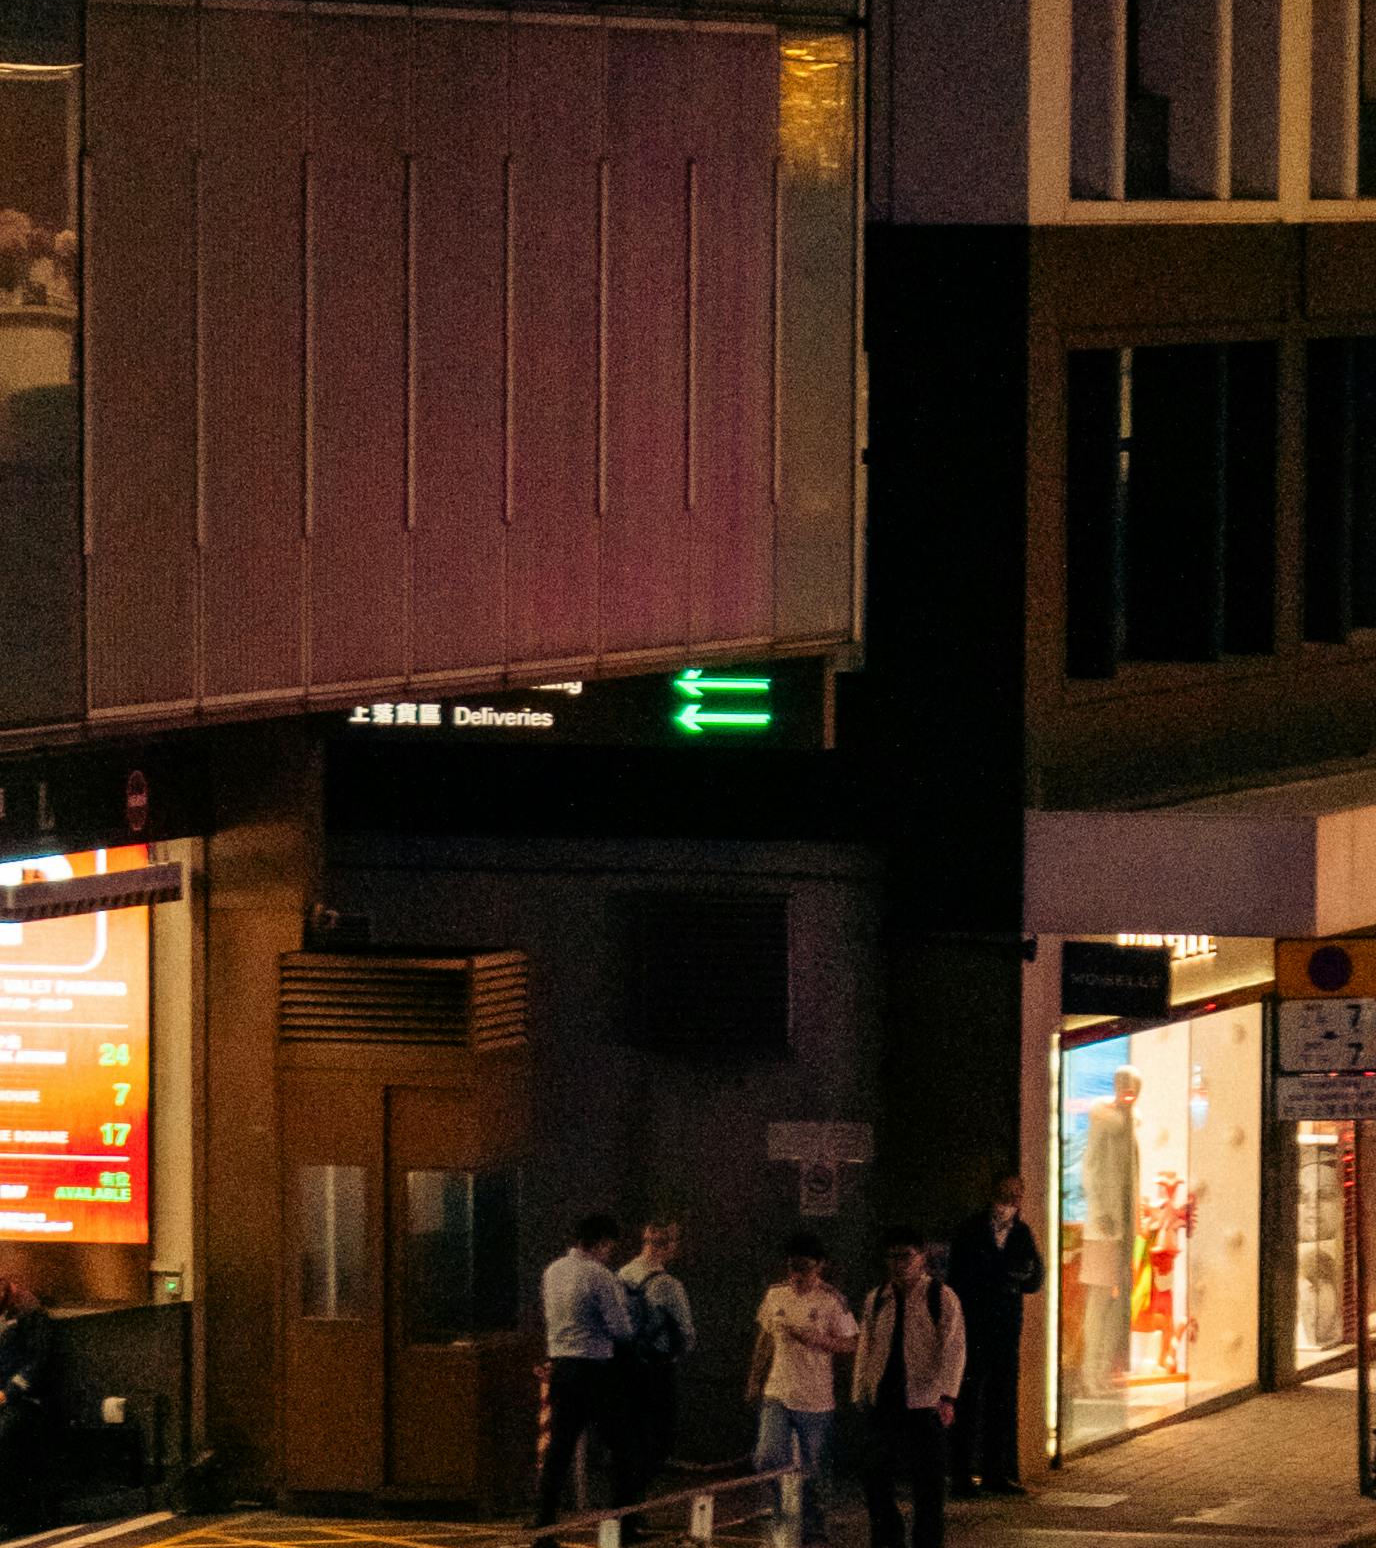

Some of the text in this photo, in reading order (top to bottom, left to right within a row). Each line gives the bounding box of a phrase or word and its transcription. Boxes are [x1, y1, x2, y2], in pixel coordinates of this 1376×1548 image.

[349, 702, 553, 727] 上落貨區 Deliveries
[99, 1043, 131, 1066] 24
[111, 1082, 131, 1106] 7
[100, 1122, 131, 1146] 17
[55, 1187, 131, 1202] AVAILABLE
